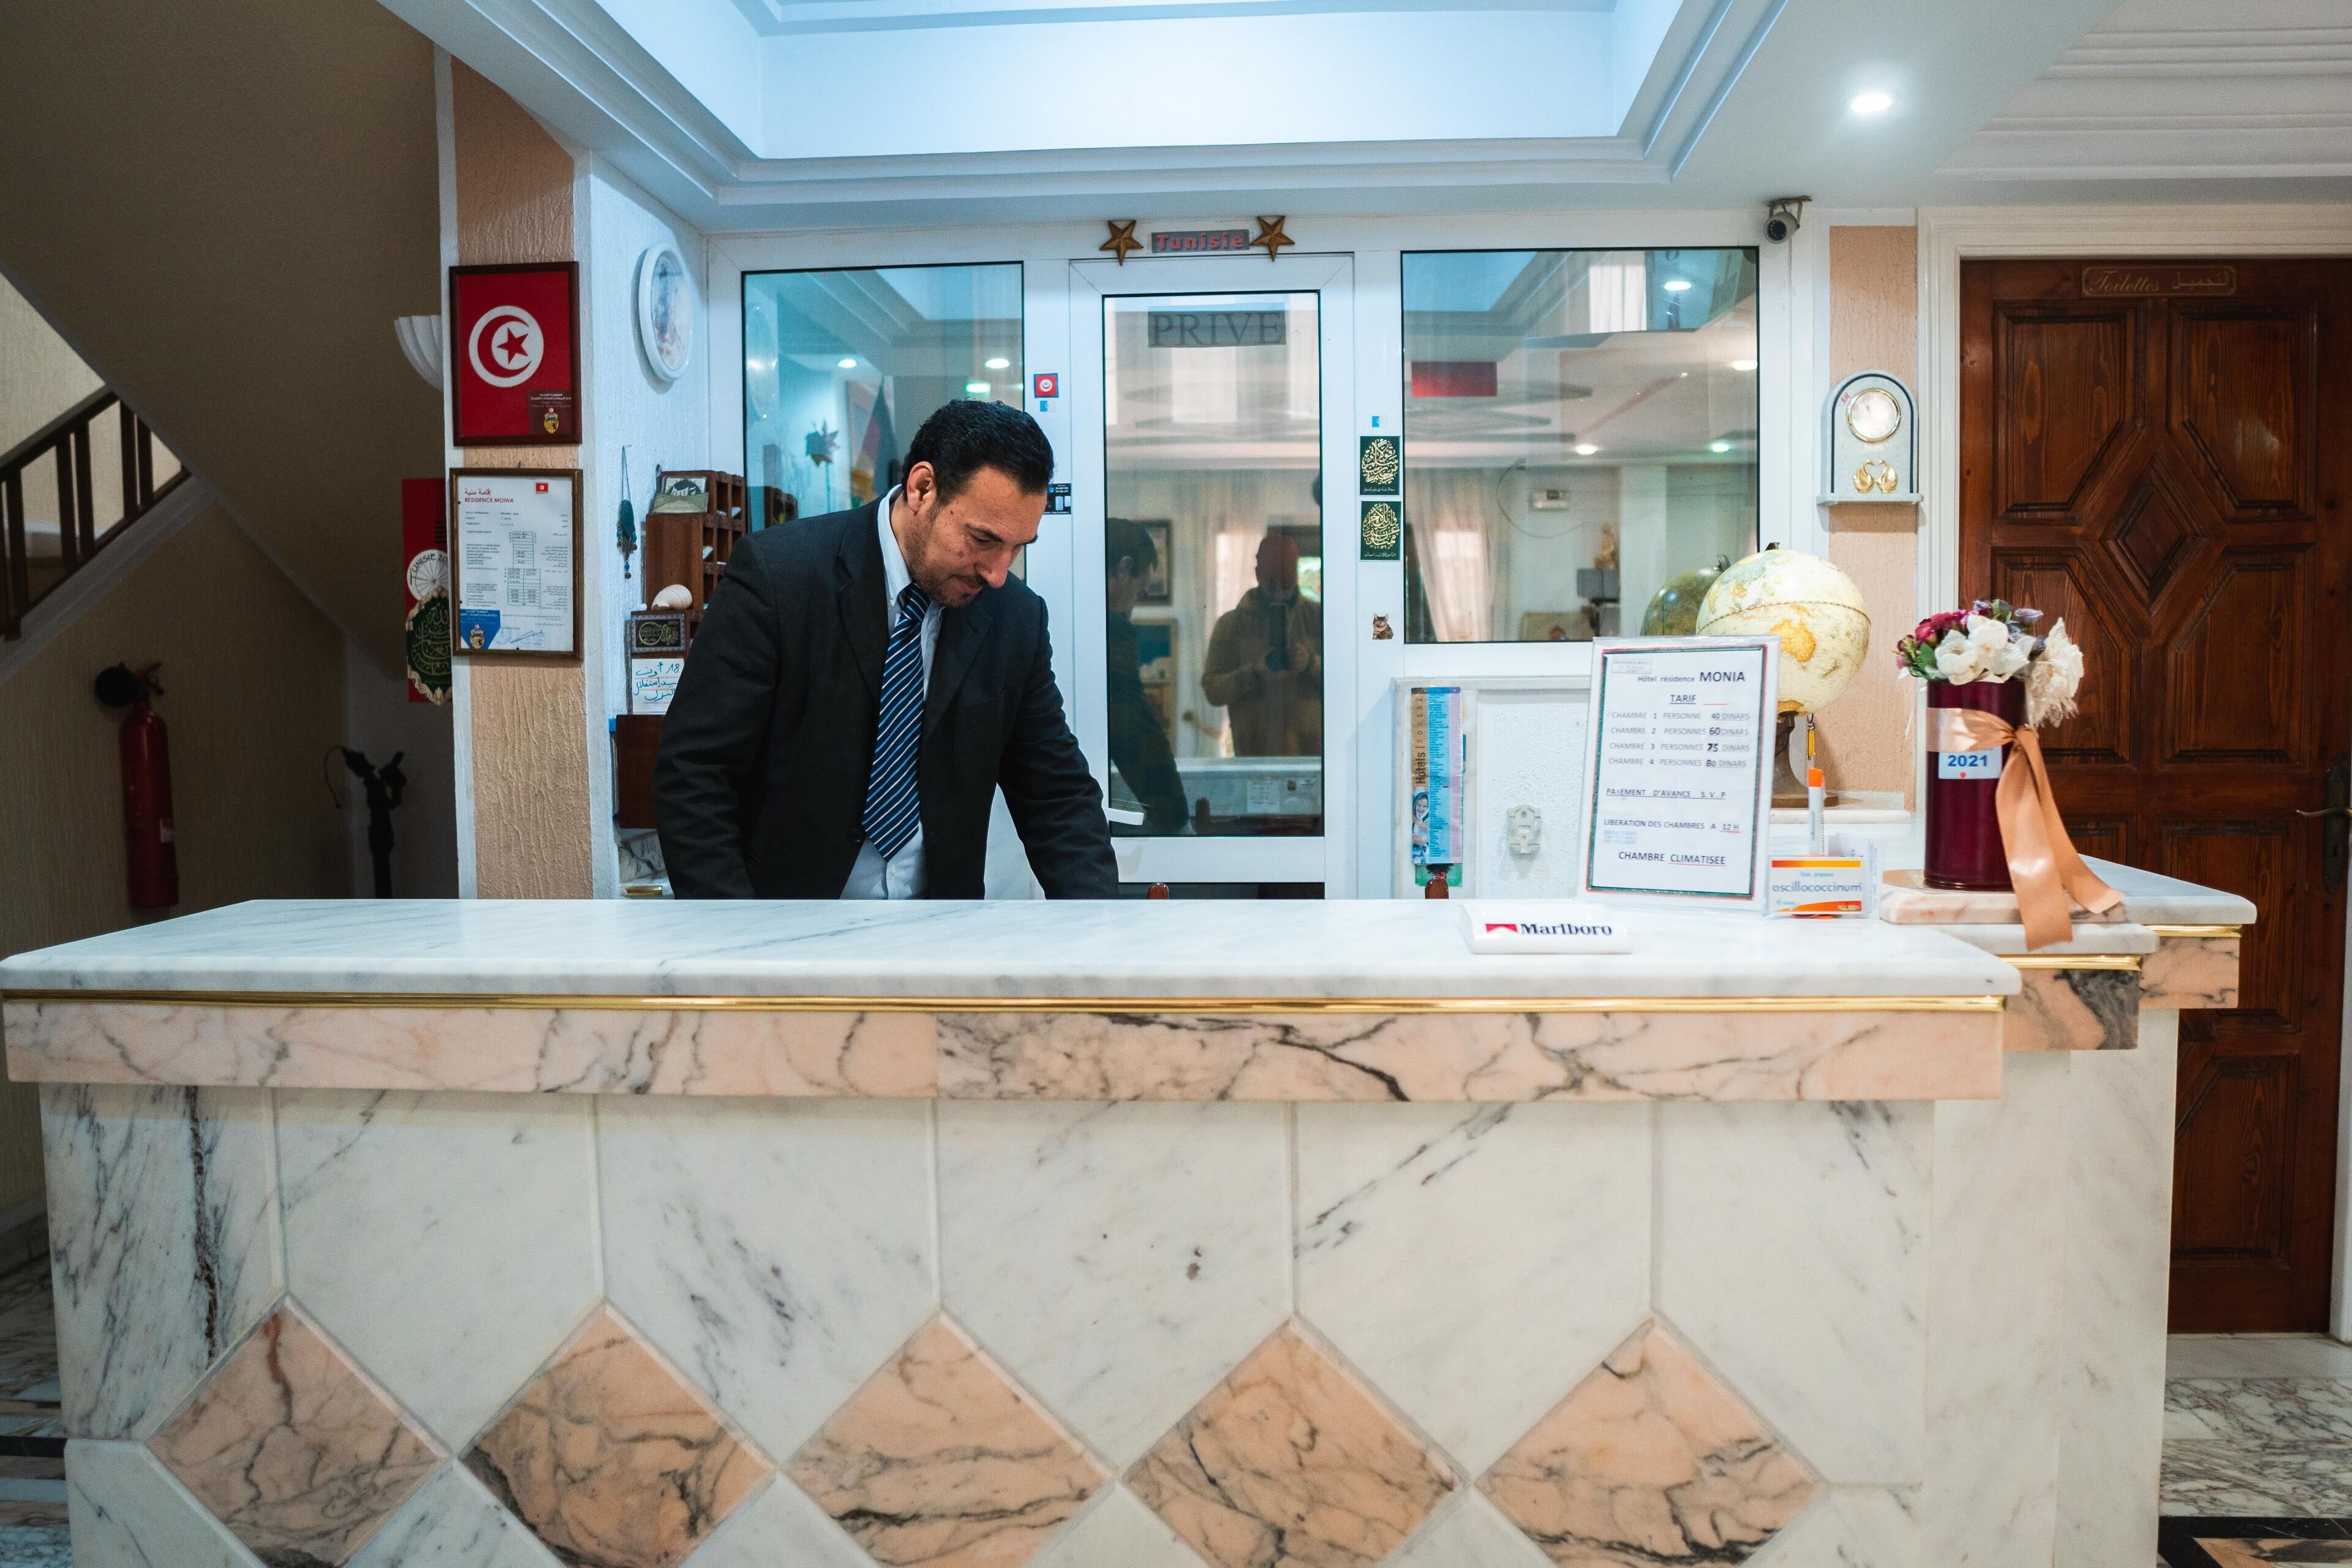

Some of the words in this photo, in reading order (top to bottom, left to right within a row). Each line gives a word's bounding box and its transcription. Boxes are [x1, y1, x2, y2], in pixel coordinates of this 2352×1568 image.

[1156, 233, 1243, 250] Tunisie
[2090, 271, 2158, 292] Toilettes
[1152, 312, 1283, 346] PRIVE
[410, 553, 436, 586] TUNISIE
[438, 554, 448, 564] 20
[666, 663, 680, 674] 18
[1700, 672, 1746, 682] MONIA
[1670, 695, 1697, 703] TARIF
[1707, 743, 1718, 752] 75
[1948, 755, 1988, 767] 2021
[1415, 752, 1426, 785] Hôtels
[1618, 851, 1665, 862] CHAMBRE
[1670, 854, 1726, 865] CLIMATISEE
[1773, 881, 1861, 892] oscillococcinum
[1521, 923, 1612, 936] Marlboro
